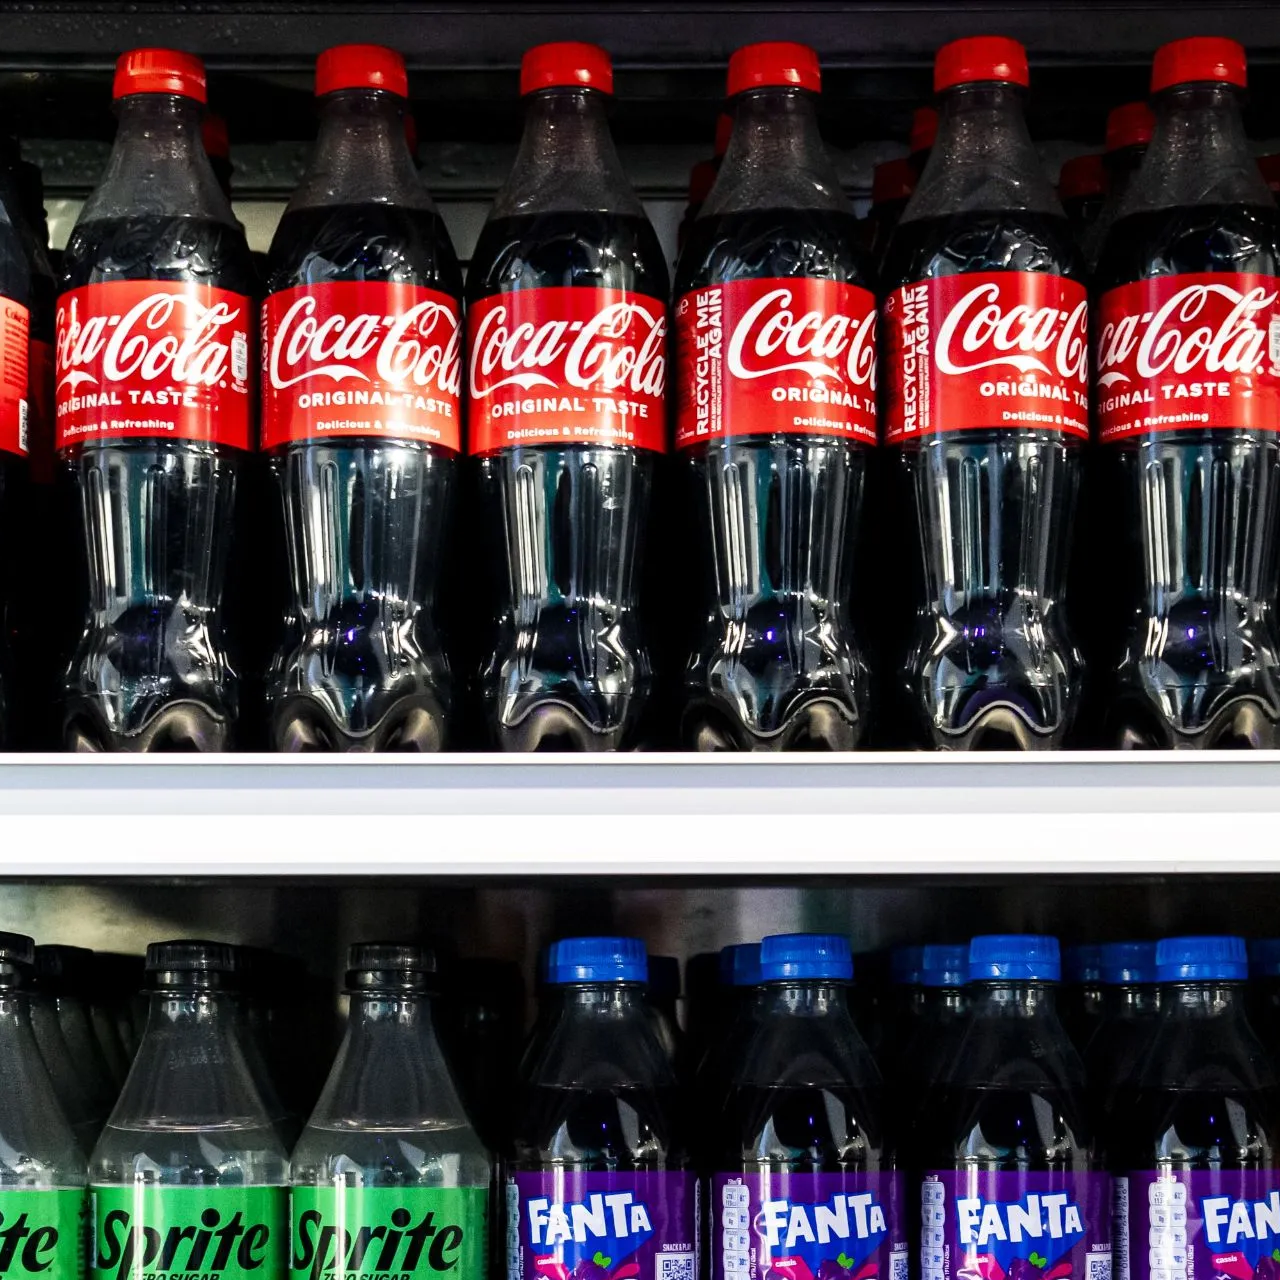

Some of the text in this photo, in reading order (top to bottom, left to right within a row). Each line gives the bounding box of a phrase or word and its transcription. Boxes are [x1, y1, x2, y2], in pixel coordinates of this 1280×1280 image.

[709, 287, 722, 360] AGAIN
[915, 284, 928, 357] AGAIN
[1097, 283, 1279, 388] ca-Cola
[695, 292, 710, 435] RECYCLE ME
[901, 286, 917, 433] RECYCLE ME
[57, 389, 196, 418] ORIGINAL TASTE
[298, 390, 452, 418] ORIGINAL TASTE
[771, 386, 860, 410] ORIGINAL
[979, 381, 1071, 402] ORIGINAL
[1097, 382, 1230, 415] RIGINAL TASTE
[491, 397, 649, 418] ORIGINAL TASTE
[1002, 411, 1053, 424] Delicious
[1143, 412, 1209, 426] Refreshing
[110, 418, 175, 431] Refreshing
[507, 428, 559, 440] Delicious
[574, 427, 634, 440] Refreshing
[793, 416, 843, 430] Delicious
[527, 1192, 652, 1246] FANTA
[763, 1192, 887, 1248] FANTA
[956, 1192, 1083, 1246] FANTA
[1215, 1254, 1239, 1265] cassis
